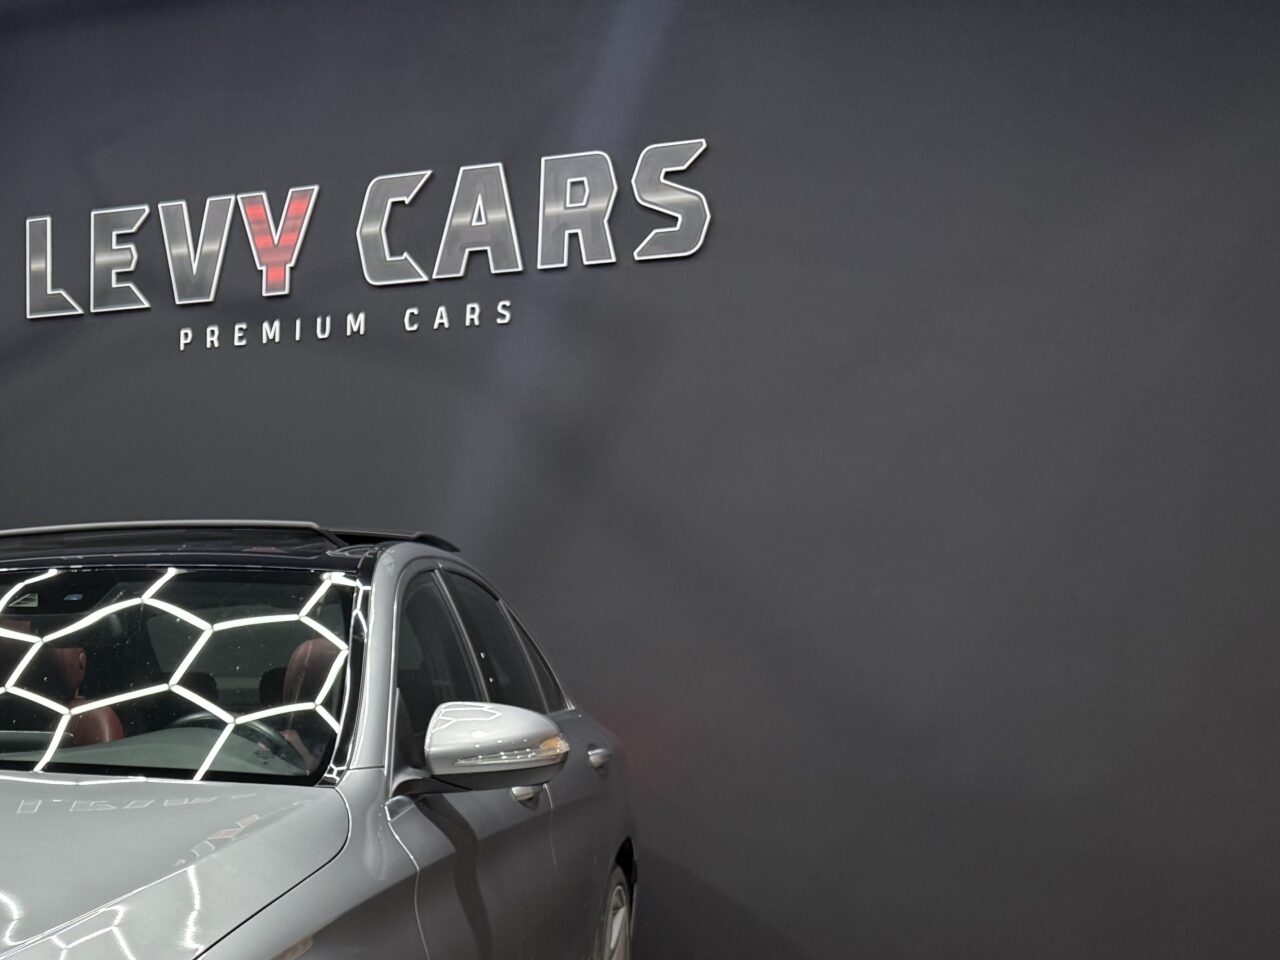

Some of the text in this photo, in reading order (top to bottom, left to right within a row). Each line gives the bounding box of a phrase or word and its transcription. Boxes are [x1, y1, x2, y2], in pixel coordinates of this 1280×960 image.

[26, 138, 711, 319] LEVY CARS
[179, 300, 512, 350] PREMIUM CARS
